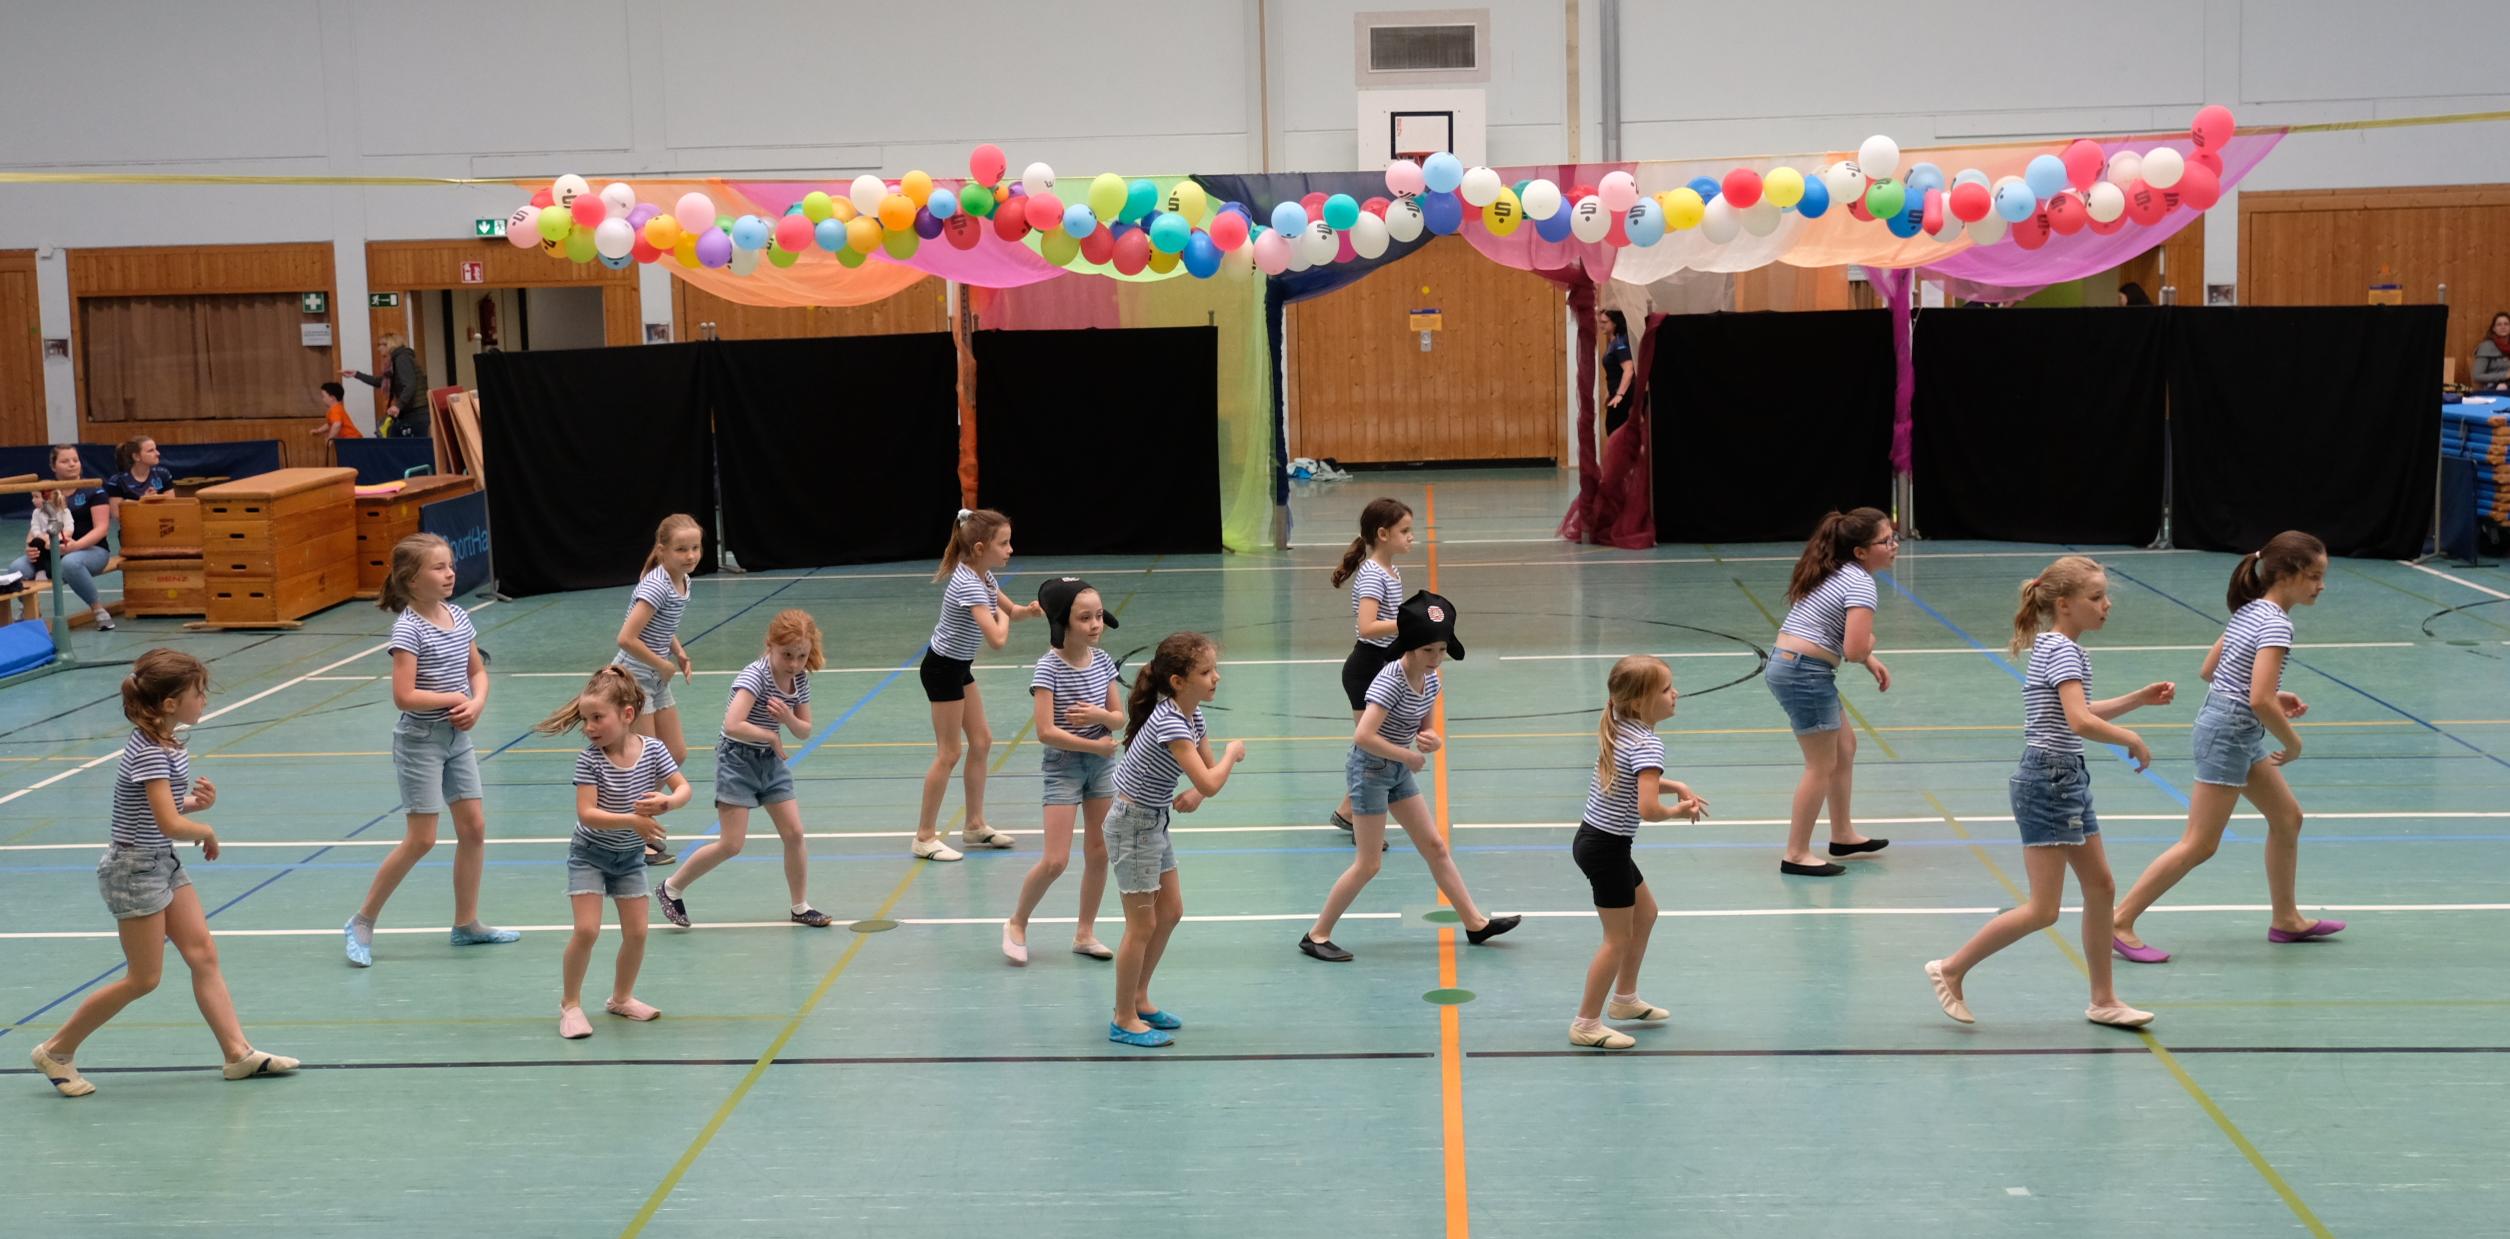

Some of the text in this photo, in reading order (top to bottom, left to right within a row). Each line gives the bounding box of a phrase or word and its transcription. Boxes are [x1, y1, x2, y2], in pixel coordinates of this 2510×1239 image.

[1494, 202, 1512, 217] S
[1580, 202, 1597, 215] S
[1628, 204, 1647, 218] S
[156, 575, 189, 583] BENZ
